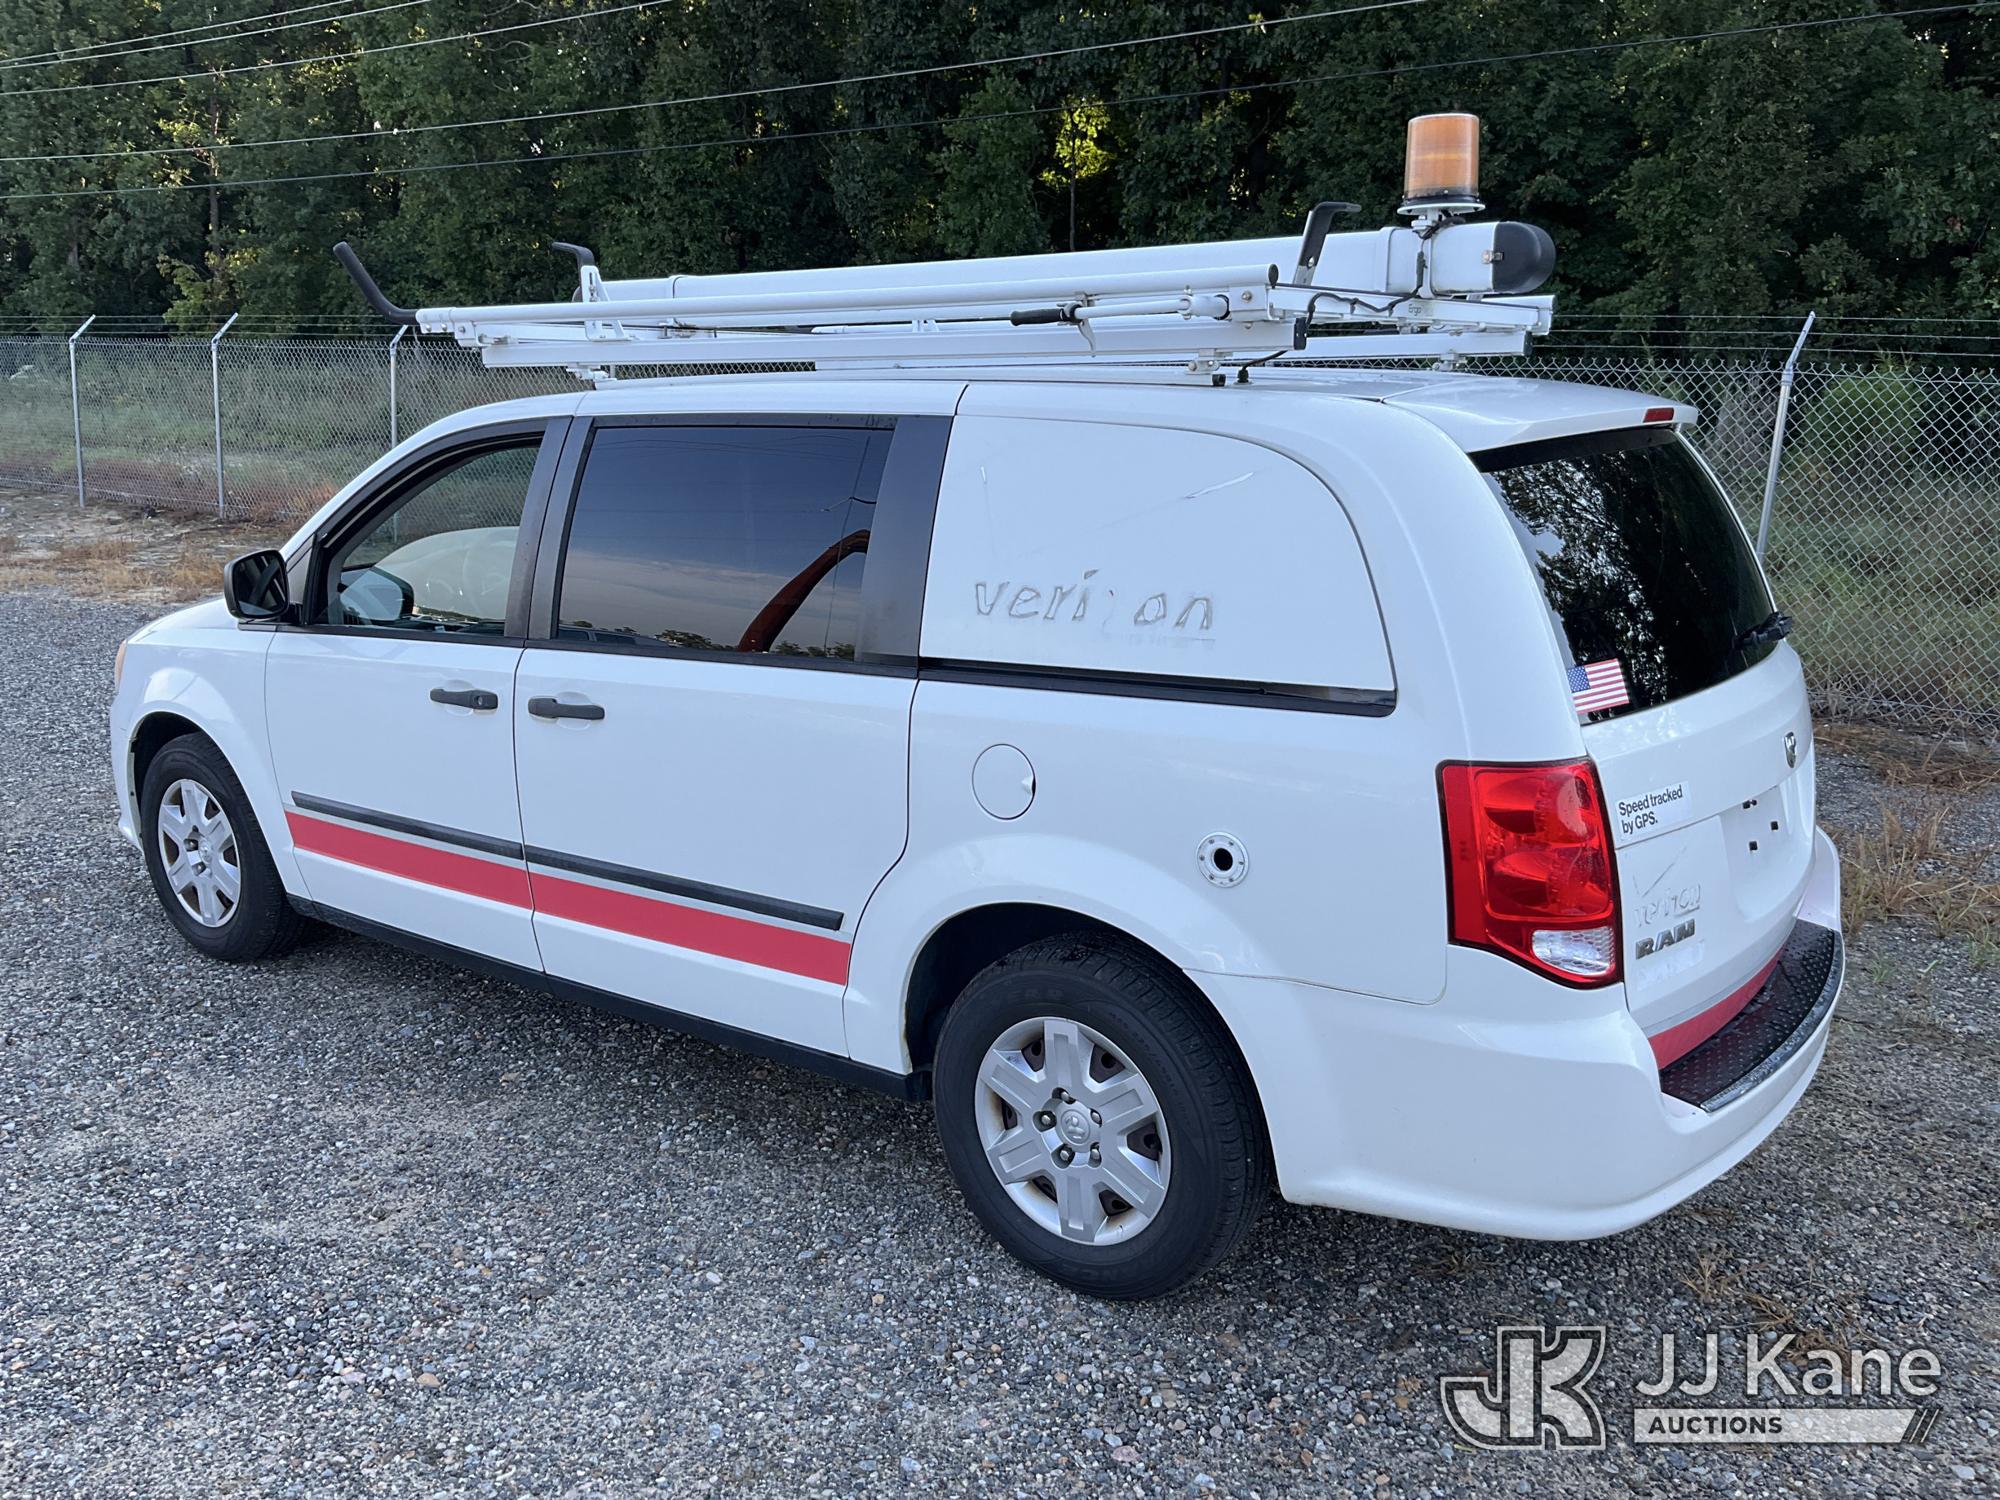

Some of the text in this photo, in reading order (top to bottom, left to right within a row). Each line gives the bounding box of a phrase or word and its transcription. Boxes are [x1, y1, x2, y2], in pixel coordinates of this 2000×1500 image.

[975, 569, 1213, 631] verion
[1618, 784, 1683, 817] Speed tracked
[1621, 811, 1658, 835] by GPS.
[1635, 918, 1696, 960] RAM
